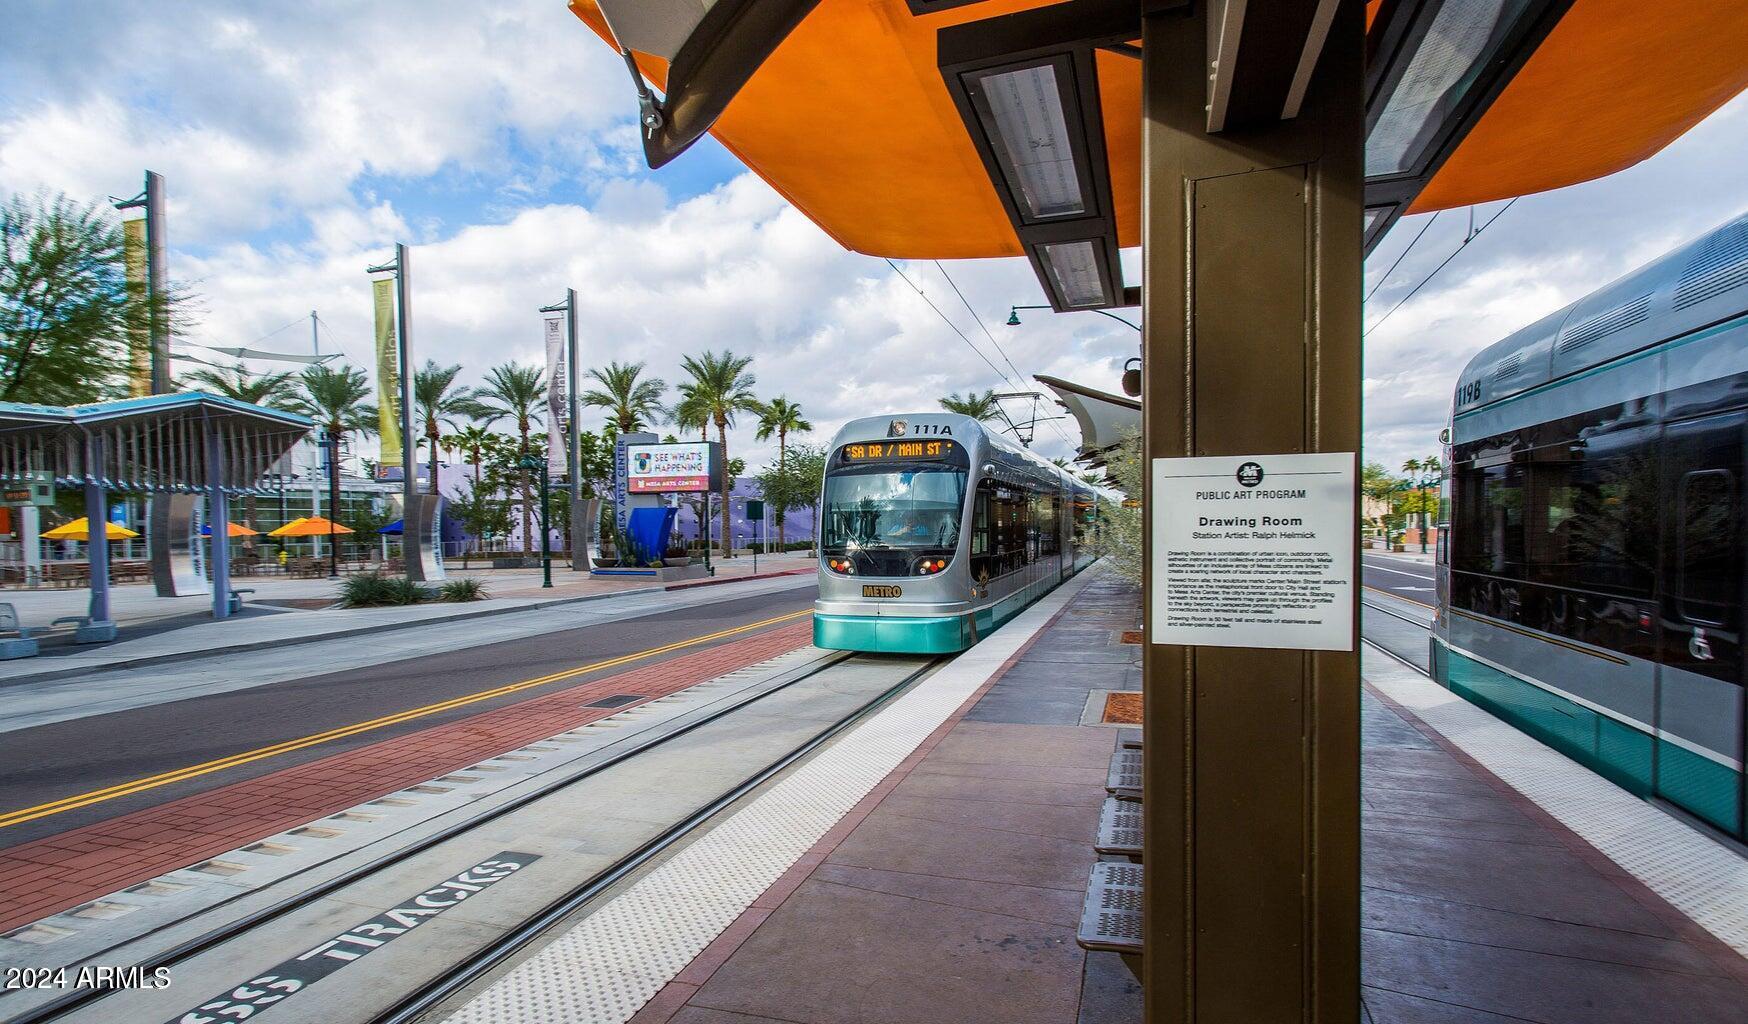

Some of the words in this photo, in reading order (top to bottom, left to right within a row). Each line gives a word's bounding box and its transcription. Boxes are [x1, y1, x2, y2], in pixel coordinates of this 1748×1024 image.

[1458, 380, 1481, 406] 119B
[557, 408, 567, 434] arts
[914, 424, 952, 435] 111A
[868, 444, 882, 457] DR
[886, 444, 894, 456] /
[898, 444, 923, 456] MAIN
[927, 442, 941, 454] ST
[655, 453, 668, 462] SEE
[672, 452, 702, 461] WHAT'S
[655, 463, 702, 472] HAPPENING
[1196, 491, 1230, 500] PUBLIC
[1233, 491, 1252, 499] ART
[1256, 490, 1306, 499] PROGRAM
[1199, 517, 1256, 527] Drawing
[1262, 517, 1302, 526] Room
[863, 586, 901, 597] METRO
[298, 861, 522, 961] TRACKS
